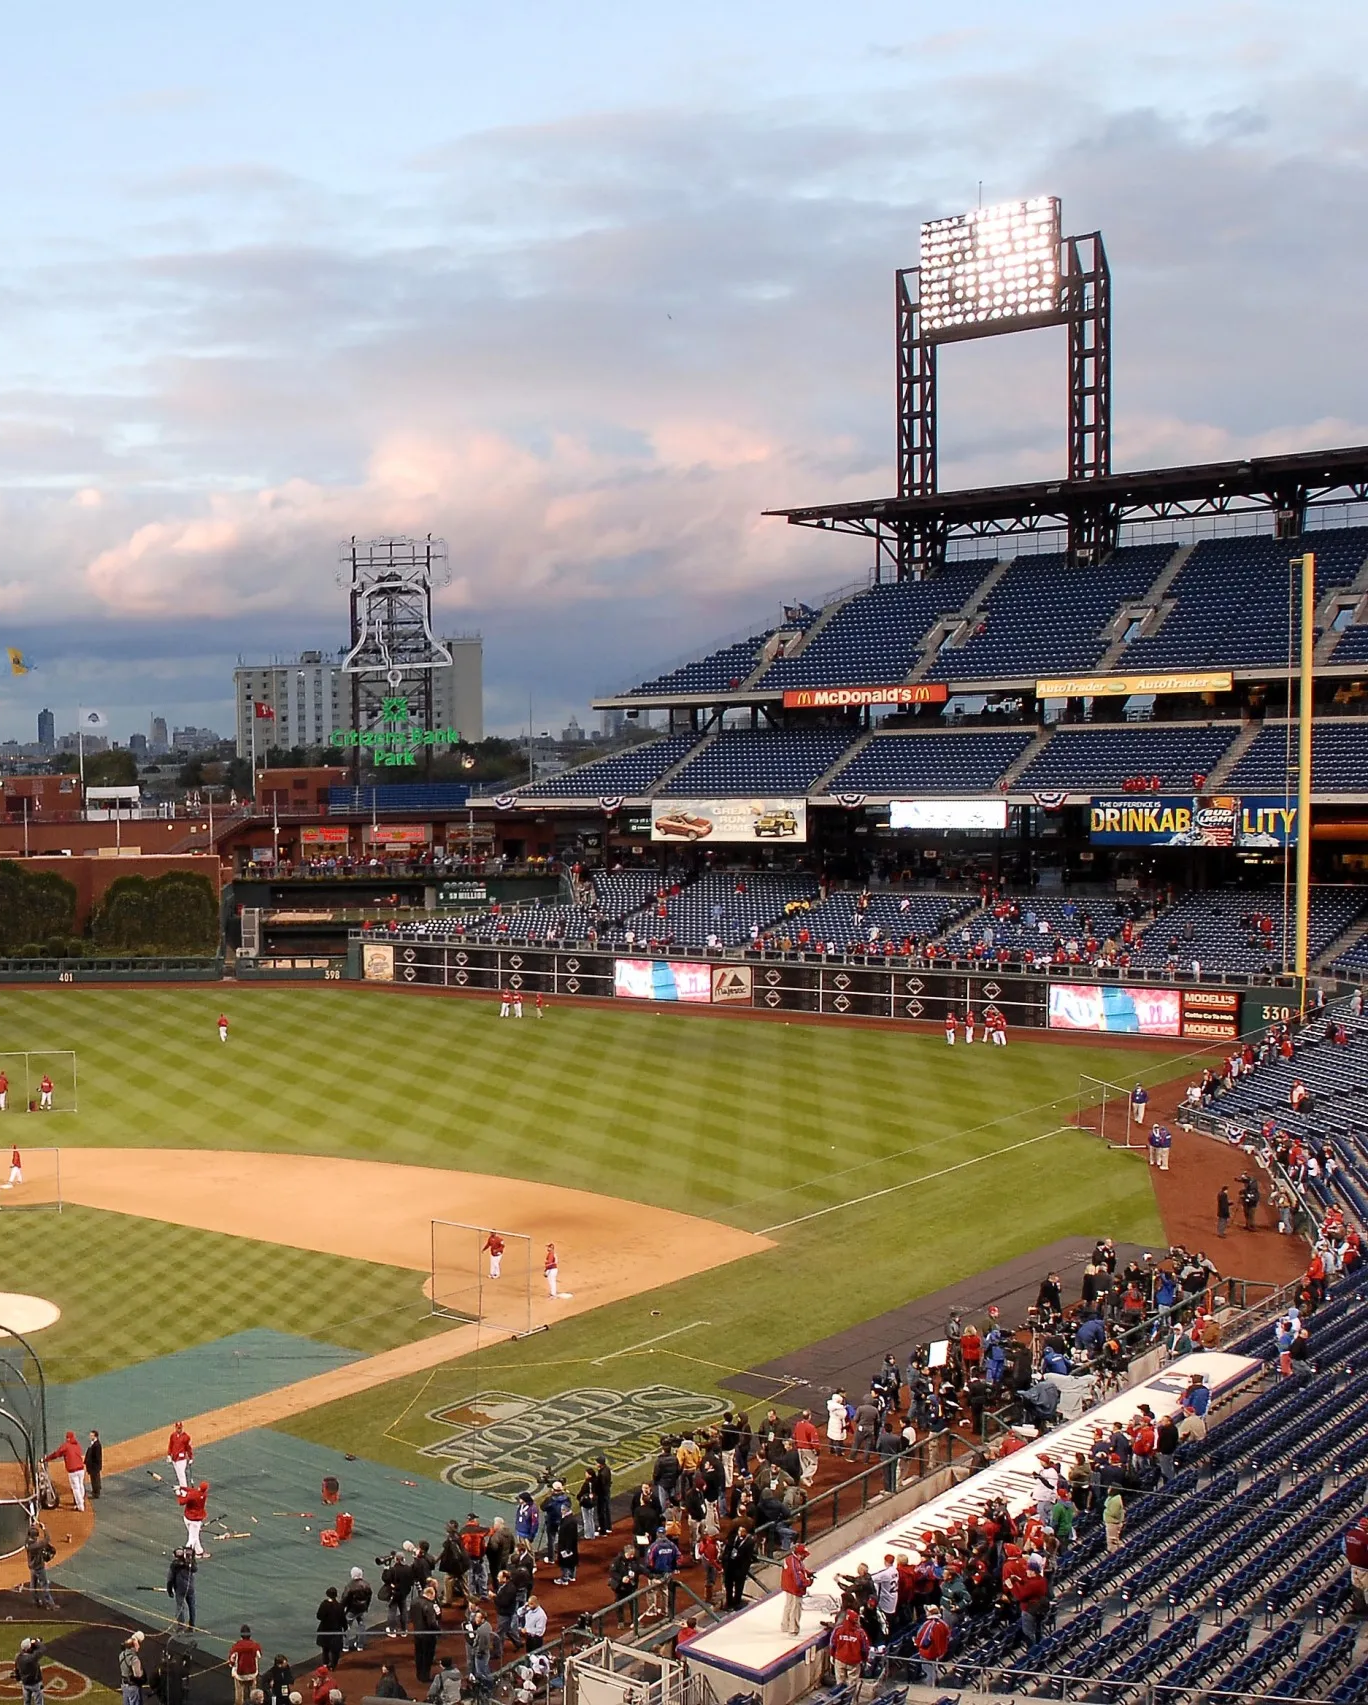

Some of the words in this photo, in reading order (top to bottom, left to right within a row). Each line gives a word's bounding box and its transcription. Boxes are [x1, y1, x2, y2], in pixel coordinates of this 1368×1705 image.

[1037, 681, 1106, 695] AutoTrader
[1136, 678, 1209, 691] AutoTrader
[814, 688, 911, 706] McDonald's
[330, 730, 407, 746] Citizens
[411, 727, 459, 744] Bank
[374, 750, 416, 766] Park
[712, 807, 752, 815] GREAT
[777, 802, 803, 812] Jeep
[714, 824, 752, 832] HOME
[59, 972, 73, 982] 401
[324, 970, 340, 980] 398
[715, 985, 749, 998] Majestic
[1184, 993, 1235, 1005] MODELL'S
[1262, 1006, 1290, 1020] 330
[1184, 1024, 1235, 1036] MODELL'S
[427, 1389, 622, 1464] WORLD
[445, 1387, 730, 1502] SERIES
